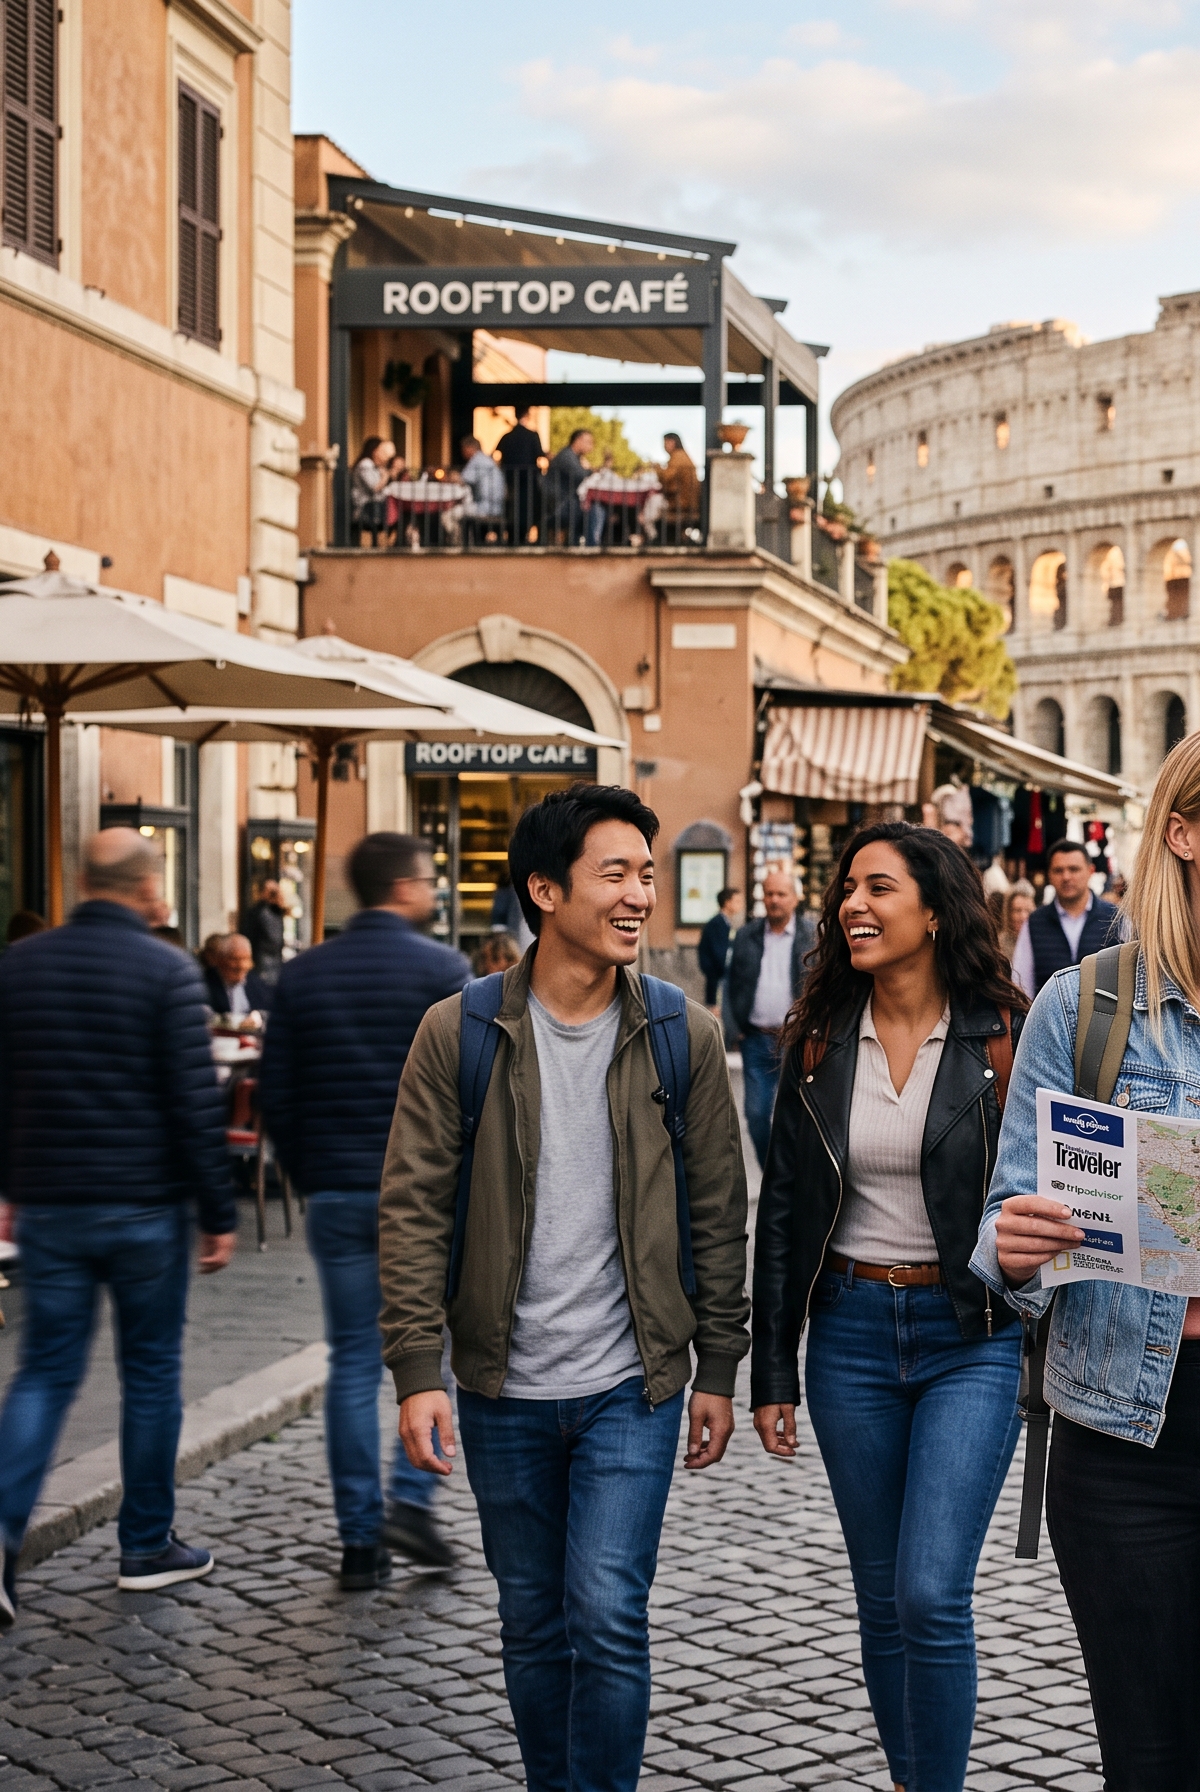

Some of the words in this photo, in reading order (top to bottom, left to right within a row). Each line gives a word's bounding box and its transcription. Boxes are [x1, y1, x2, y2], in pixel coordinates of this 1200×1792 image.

[383, 281, 575, 314] ROOFTOP
[584, 273, 689, 314] CAFÉ
[415, 743, 523, 764] ROOFTOP
[1053, 1140, 1122, 1179] Traveler
